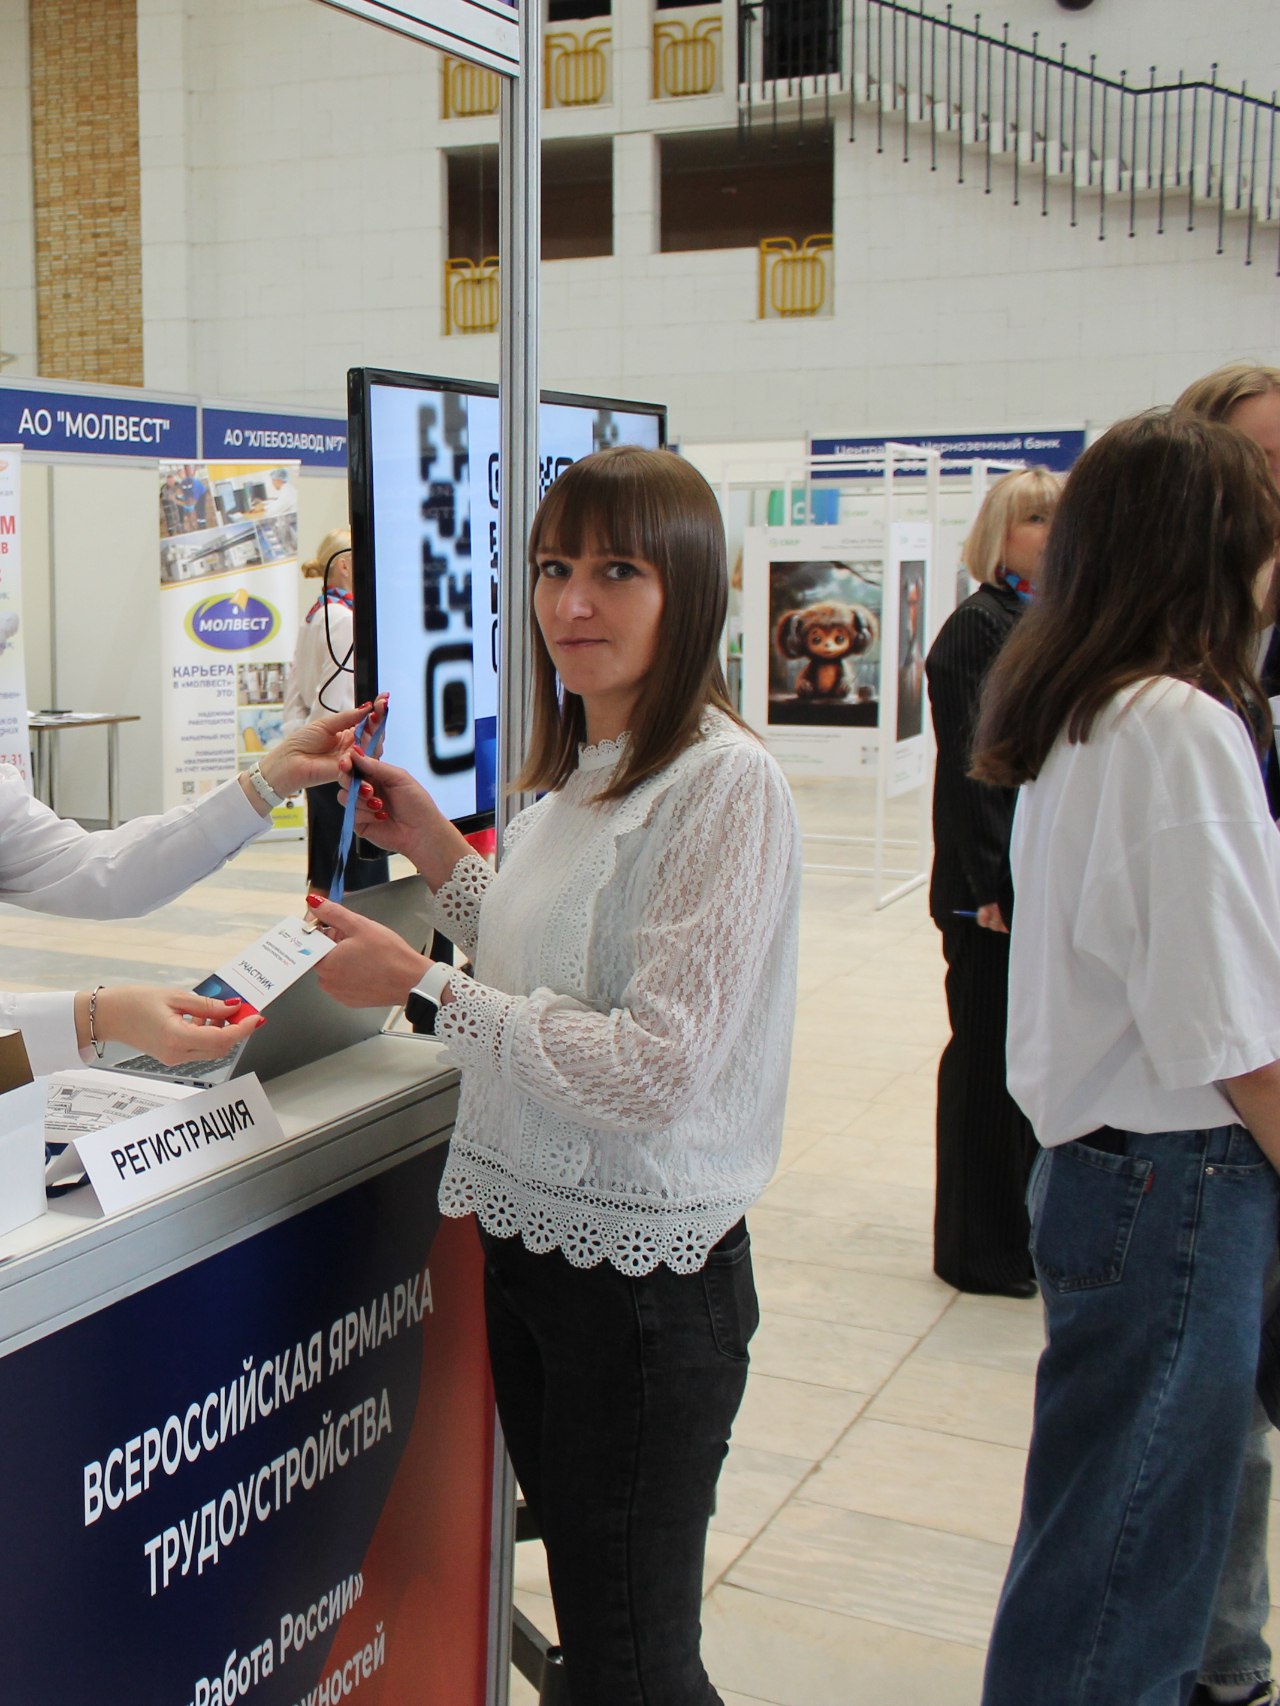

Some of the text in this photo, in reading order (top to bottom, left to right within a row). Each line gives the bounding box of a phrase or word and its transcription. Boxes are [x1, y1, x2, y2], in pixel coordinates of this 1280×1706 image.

[18, 408, 170, 443] АО "МОЛВЕСТ"
[224, 429, 242, 446] АО
[244, 430, 324, 453] "ХЛЕБОЗАВОД
[1024, 437, 1060, 450] банк
[199, 617, 269, 632] МОЛВЕСТ
[173, 664, 235, 677] КАРЬЕРА
[239, 959, 275, 991] УЧАСТНИК
[110, 1099, 255, 1180] РЕГИСТРАЦИЯ
[83, 1267, 434, 1526] ВСЕРОССИЙСКАЯ ЯРМАРКА
[144, 1388, 392, 1597] ТРУДОУСТРОЙСТВА
[280, 1572, 364, 1664] России»
